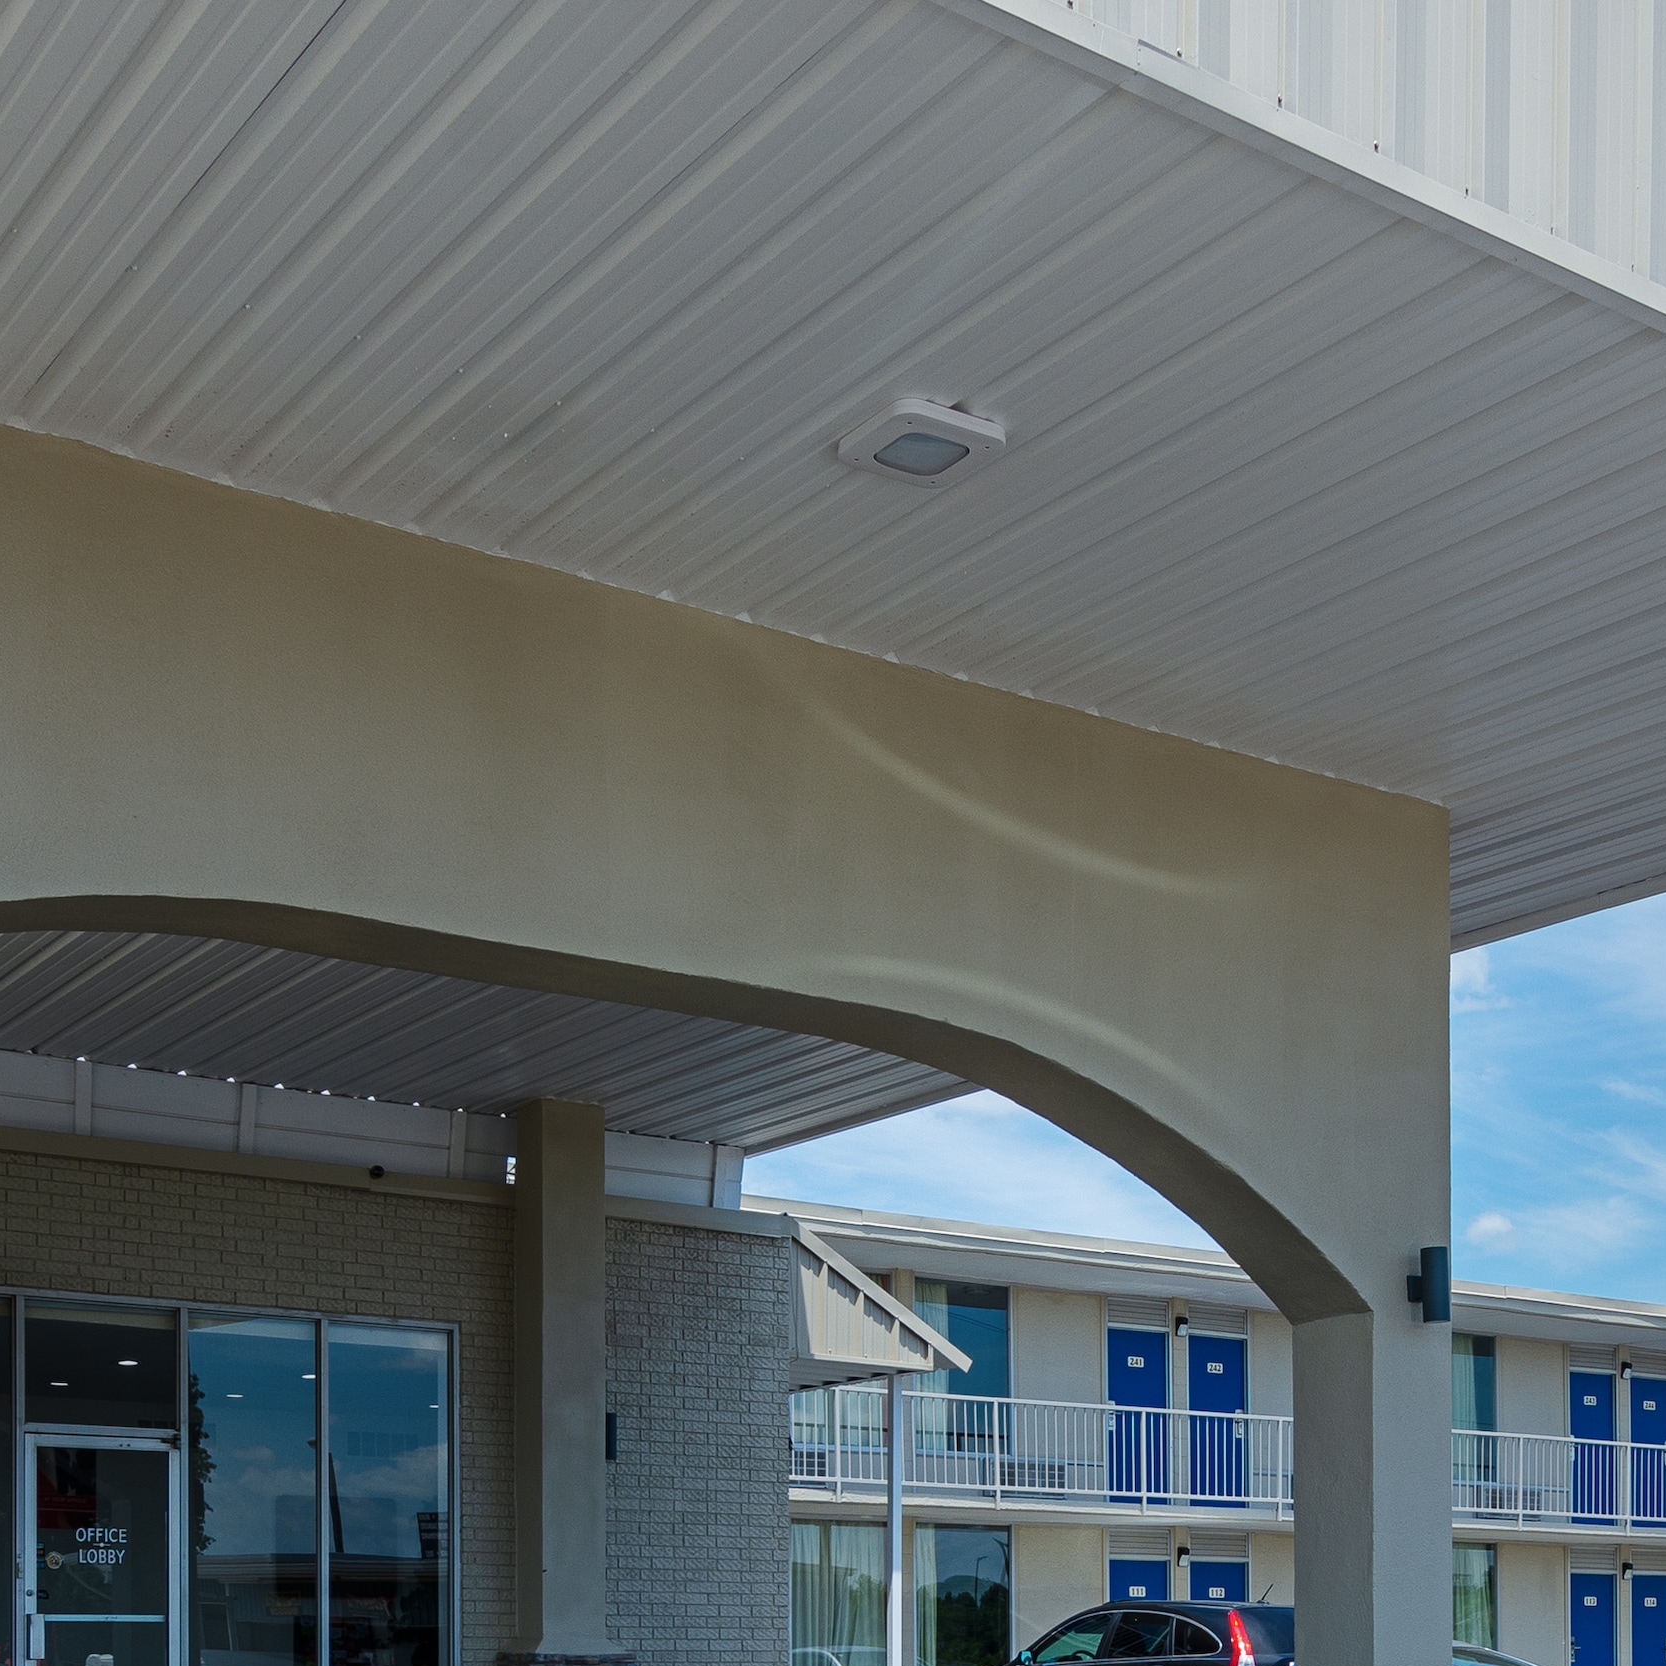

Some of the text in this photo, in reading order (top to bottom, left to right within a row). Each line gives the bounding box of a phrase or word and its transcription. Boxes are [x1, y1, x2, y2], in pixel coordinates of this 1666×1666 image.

[1129, 1357, 1143, 1367] 241
[1208, 1364, 1222, 1373] 242
[1584, 1396, 1596, 1405] 243
[75, 1527, 128, 1543] OFFICE
[79, 1548, 126, 1565] LOBBY
[1131, 1587, 1144, 1596] 111
[1210, 1588, 1224, 1597] 112
[1585, 1597, 1596, 1605] 113
[1645, 1598, 1655, 1606] 114
